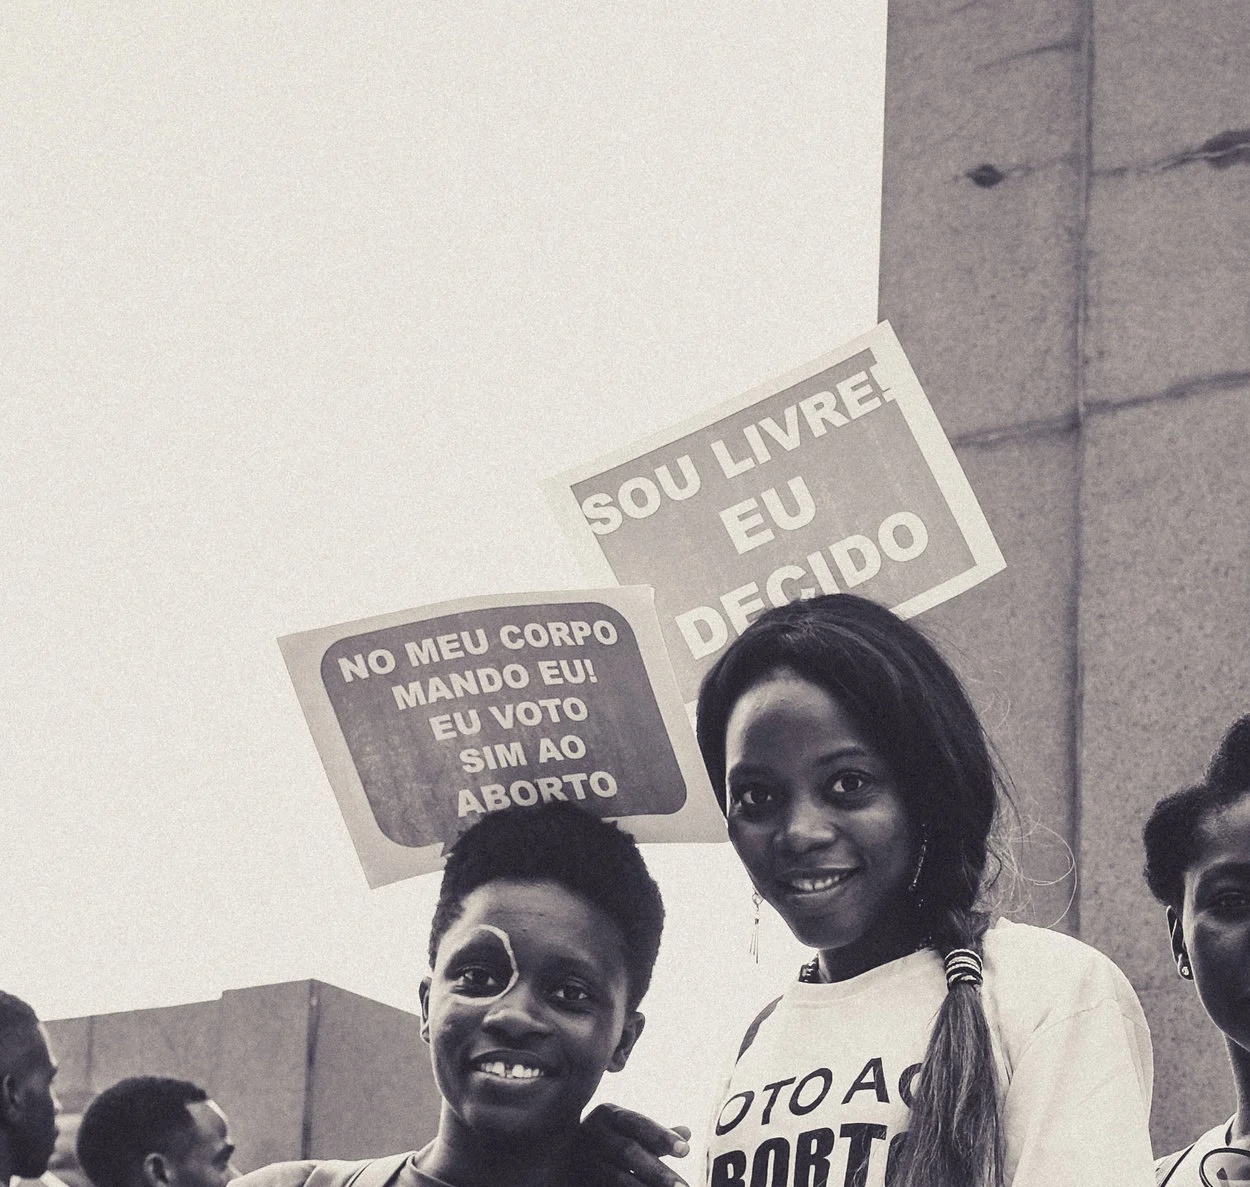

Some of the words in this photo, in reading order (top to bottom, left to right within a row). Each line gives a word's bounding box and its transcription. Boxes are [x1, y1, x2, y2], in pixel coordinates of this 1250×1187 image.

[581, 455, 702, 537] SOU
[710, 362, 898, 481] LIVRE!
[718, 475, 818, 556] EU
[674, 510, 929, 661] DECIDO
[337, 647, 397, 684] NO
[407, 628, 490, 670] MEU
[499, 618, 620, 652] CORPO
[390, 662, 531, 712] MANDO
[539, 657, 599, 687] EU!
[429, 709, 482, 742] EU
[490, 696, 590, 731] VOTO
[460, 740, 528, 775] SIM
[537, 734, 588, 764] AO
[456, 769, 620, 819] ABORTO
[715, 1065, 834, 1136] OTO
